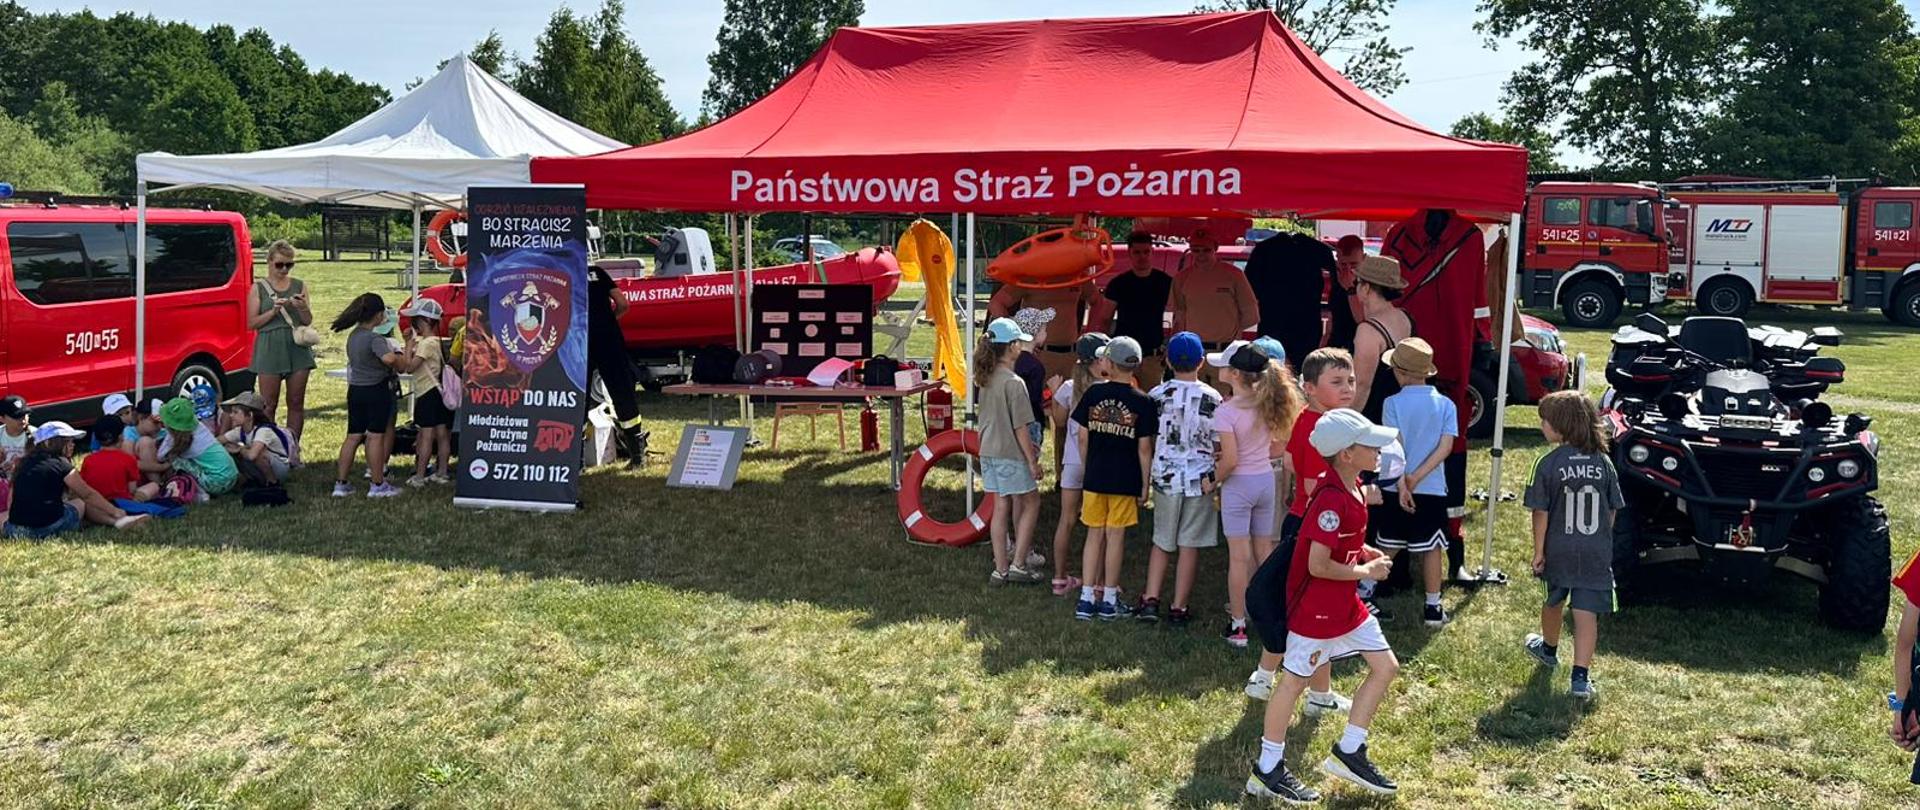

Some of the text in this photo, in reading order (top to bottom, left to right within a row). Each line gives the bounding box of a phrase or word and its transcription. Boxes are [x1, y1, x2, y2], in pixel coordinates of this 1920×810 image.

[731, 163, 1241, 203] Państwowa Straż Pożarna
[482, 217, 571, 232] BO STRACISZ
[490, 234, 563, 248] MARZENIA
[649, 284, 684, 300] STRAŻ
[470, 389, 577, 408] WSTĄP DO NAS
[468, 414, 529, 428] Młodzieżowa
[490, 428, 528, 442] Drużyna
[476, 440, 527, 453] Pożarnicza
[493, 463, 570, 483] 572 110 112
[1559, 465, 1603, 481] JAMES
[1564, 485, 1600, 535] 10
